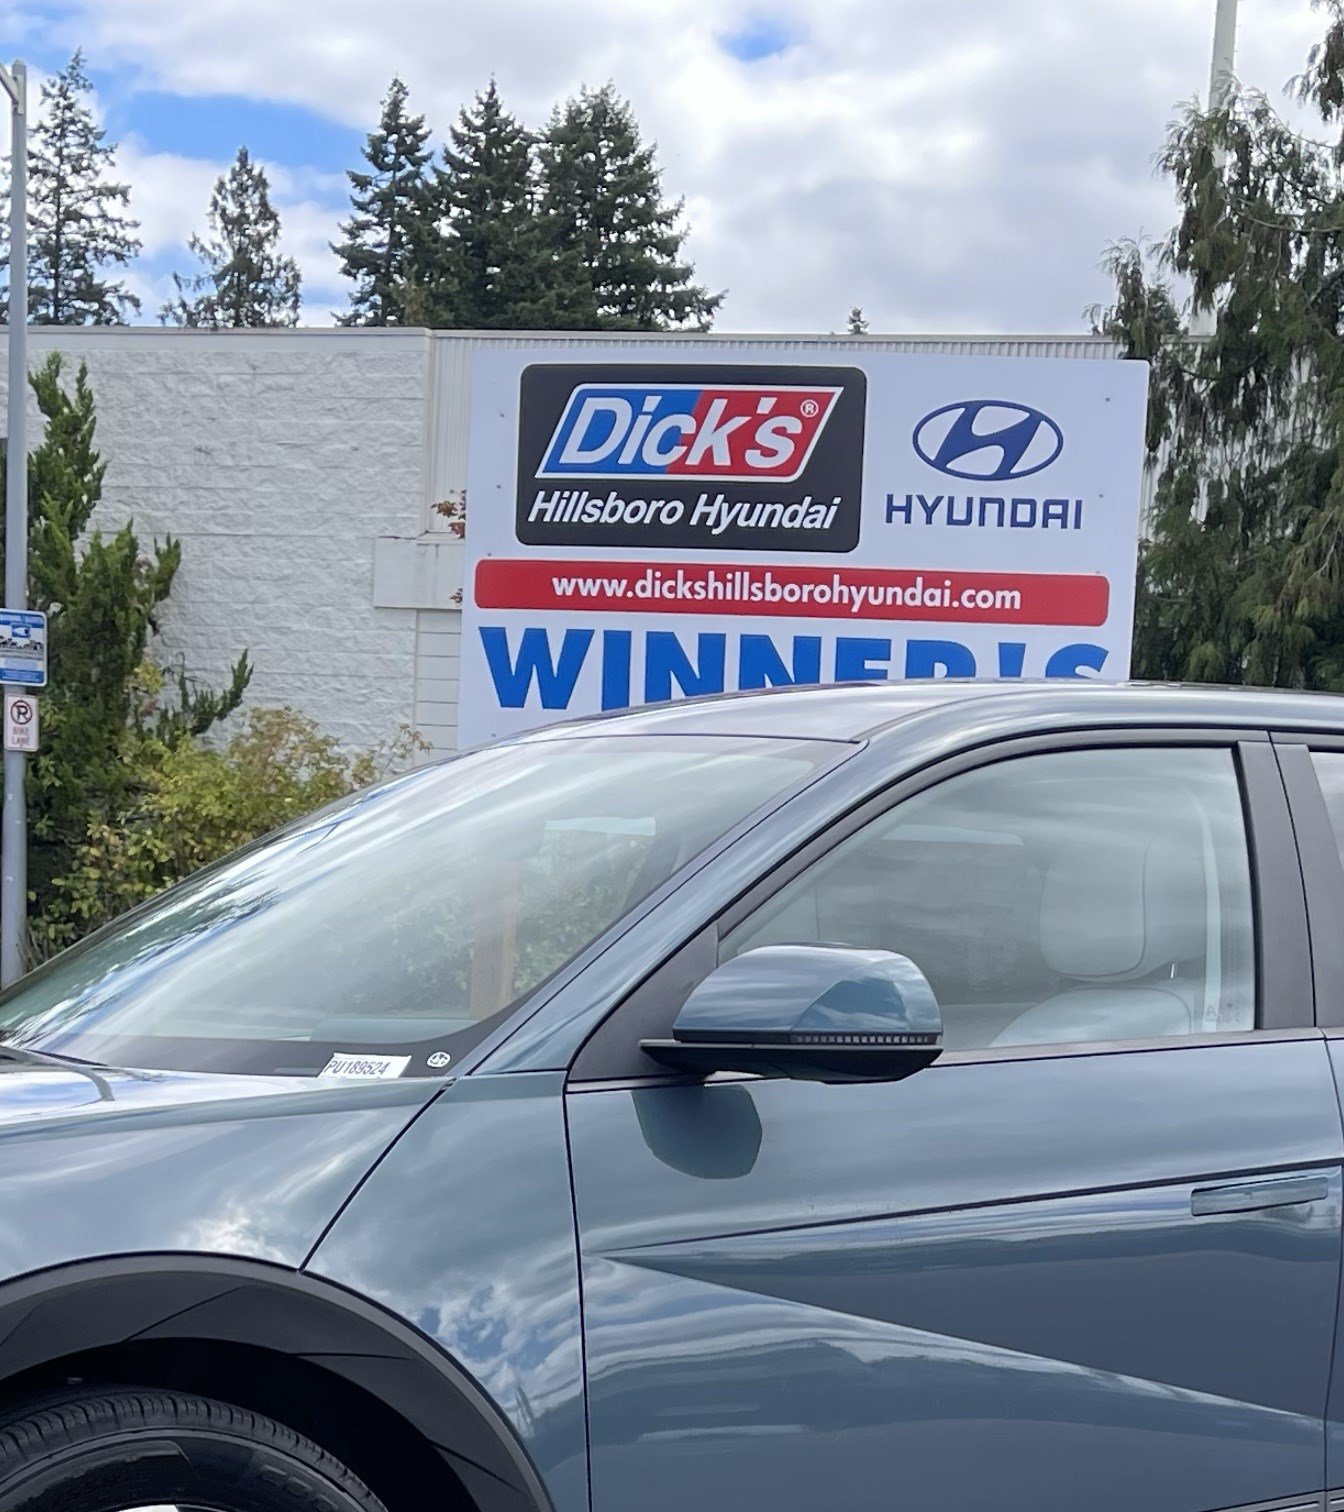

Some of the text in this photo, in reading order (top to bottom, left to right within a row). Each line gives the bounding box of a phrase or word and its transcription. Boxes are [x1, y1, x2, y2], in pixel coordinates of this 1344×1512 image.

[558, 395, 804, 469] Dick's
[527, 489, 843, 536] Hillsboro Hyundai
[884, 493, 1083, 531] HYUNDAI
[551, 569, 1022, 613] www.dickshillsborohyundai.com
